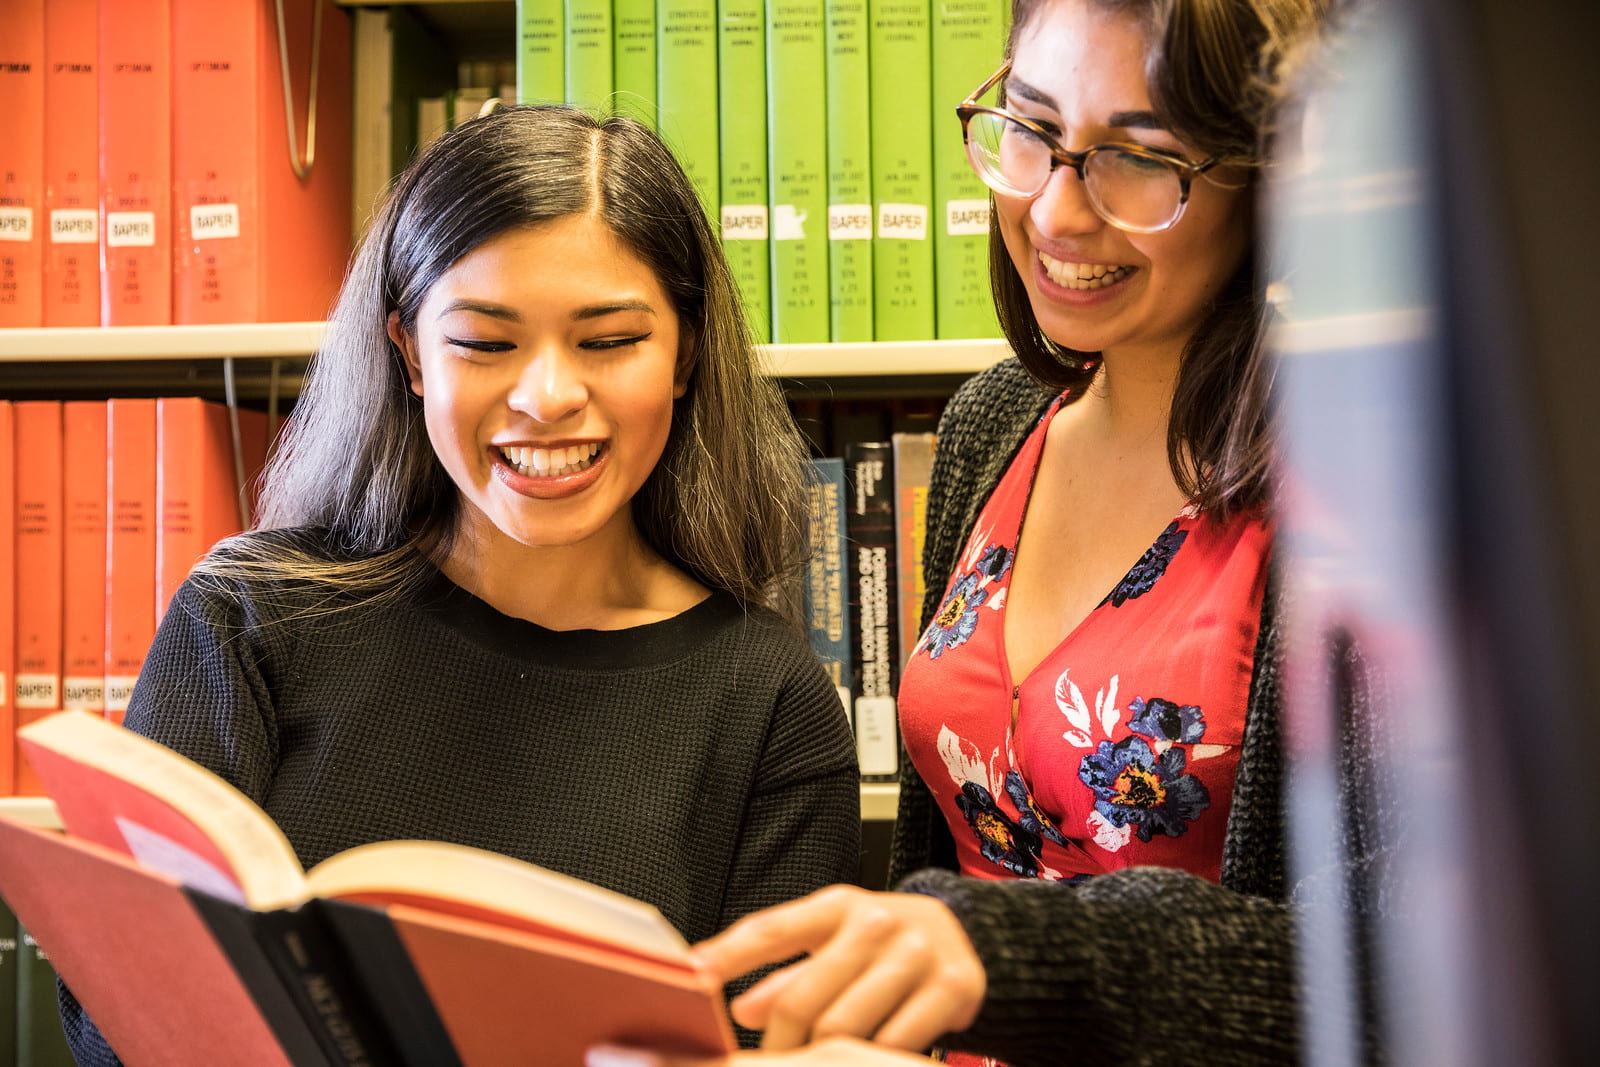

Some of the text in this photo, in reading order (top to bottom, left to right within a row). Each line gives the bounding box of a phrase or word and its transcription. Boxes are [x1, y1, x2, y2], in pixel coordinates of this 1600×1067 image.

[724, 214, 764, 231] BAPER
[882, 214, 923, 231] BAPER
[15, 681, 53, 698] BAPER
[64, 685, 102, 702] BAPER
